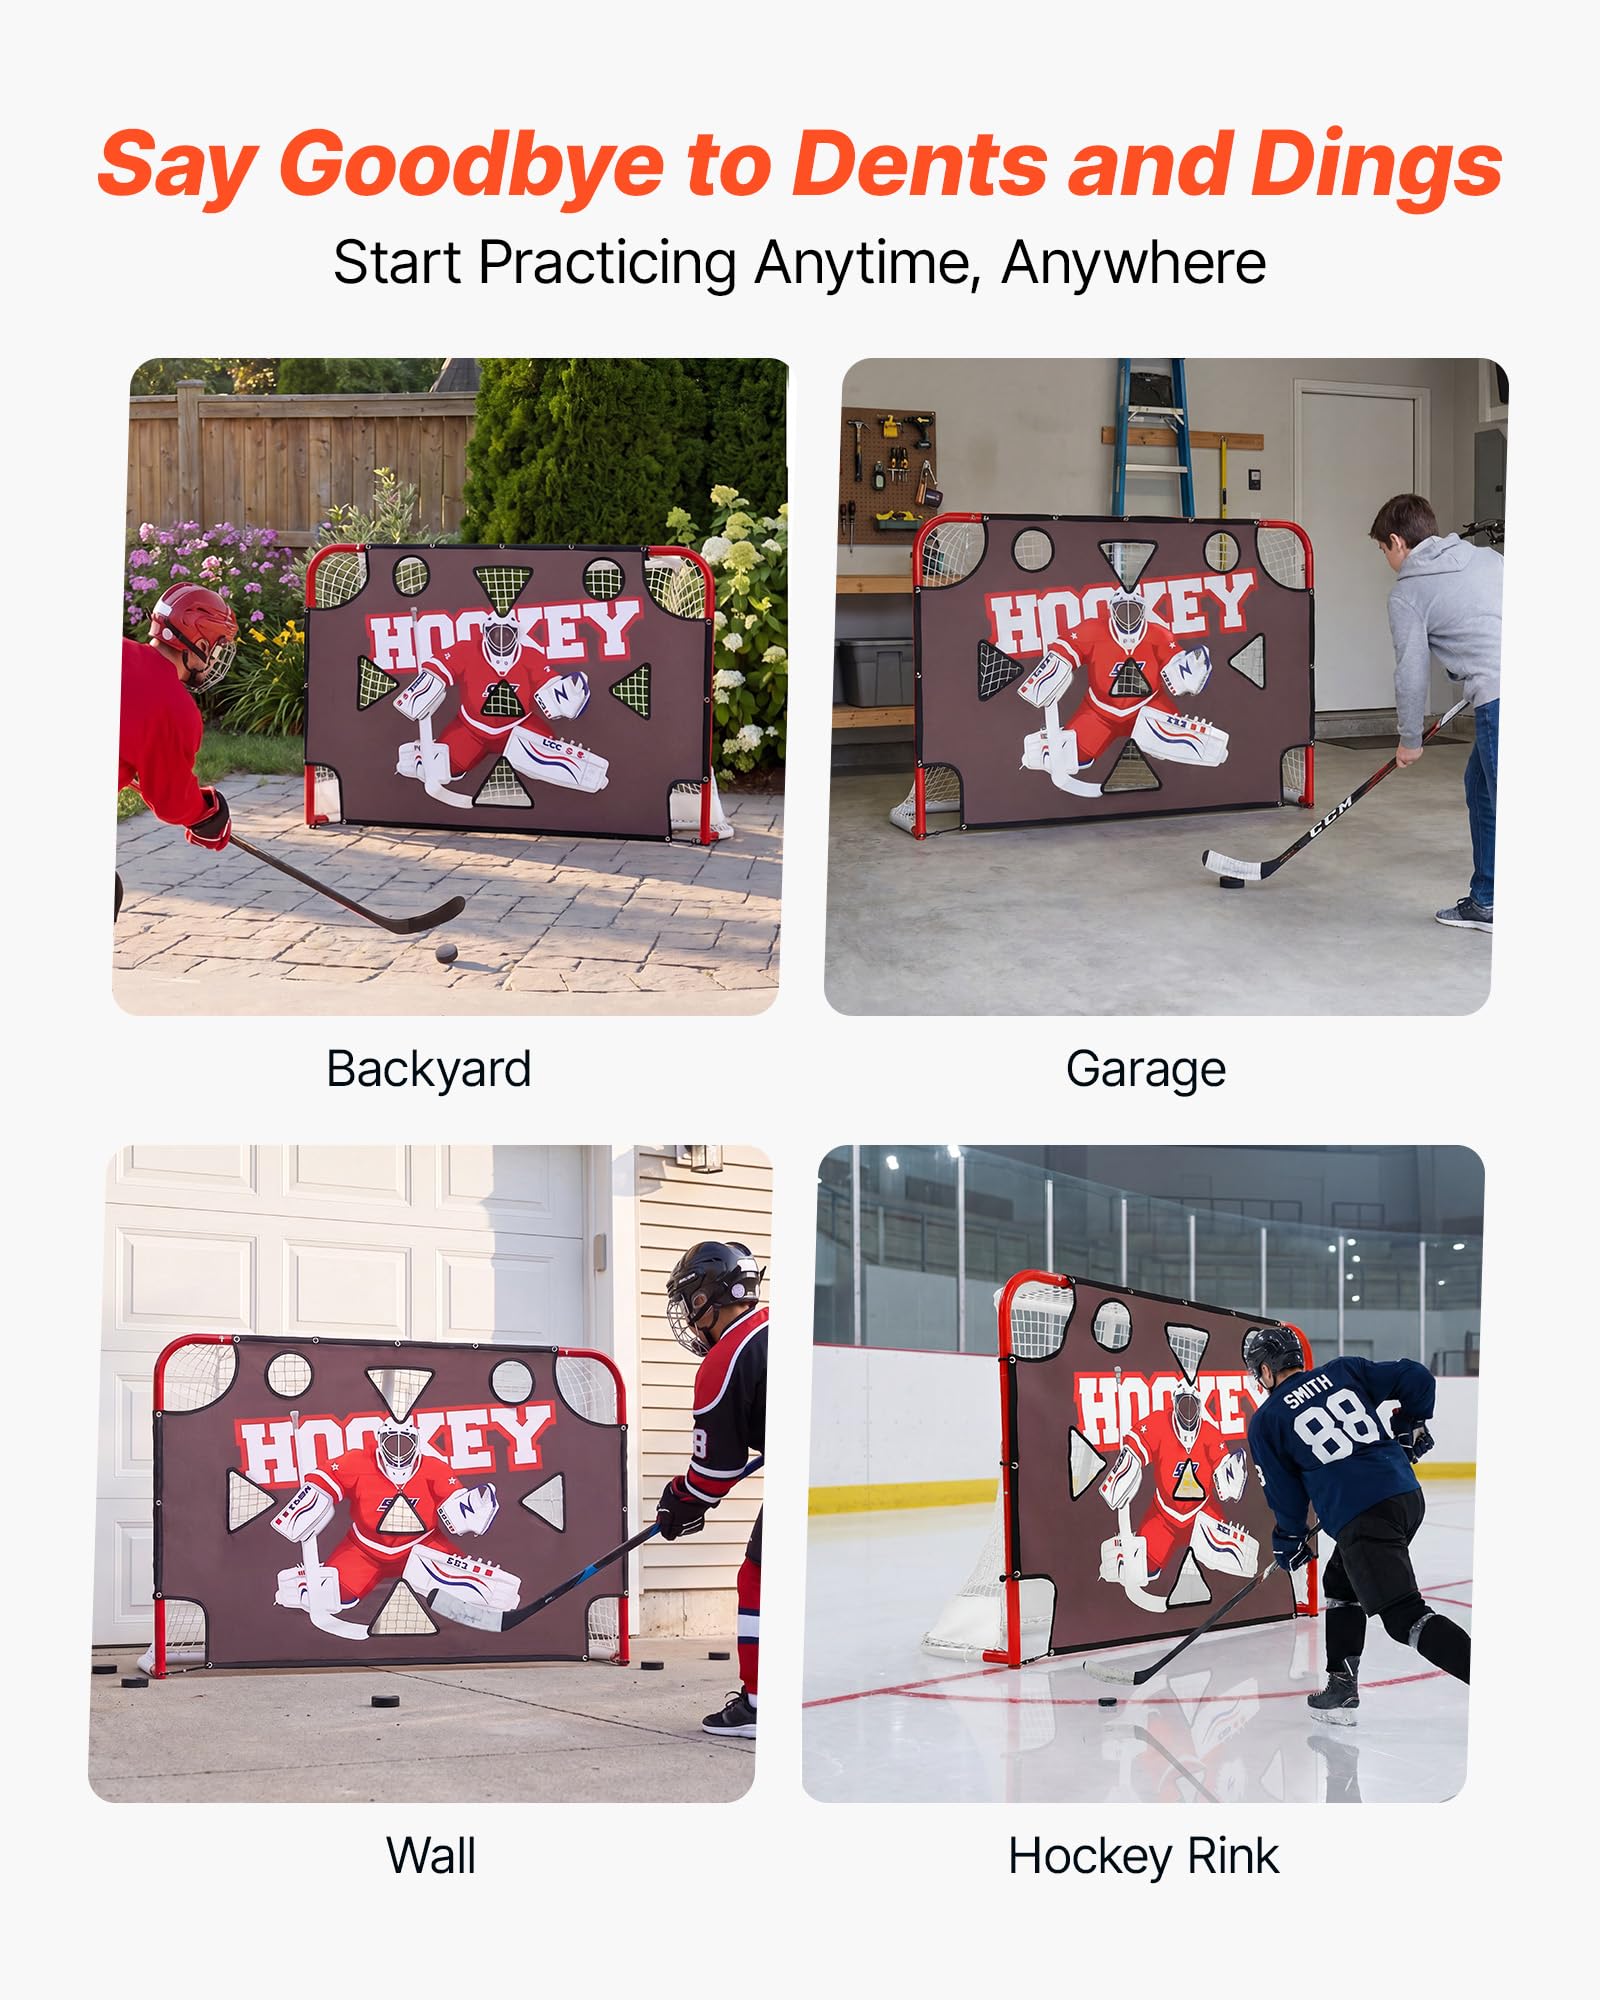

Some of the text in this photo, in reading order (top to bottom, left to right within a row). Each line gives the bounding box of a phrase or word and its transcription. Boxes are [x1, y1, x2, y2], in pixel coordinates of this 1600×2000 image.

[1310, 797, 1352, 838] CCM
[1284, 1374, 1334, 1410] SMITH
[1294, 1388, 1380, 1464] 88
